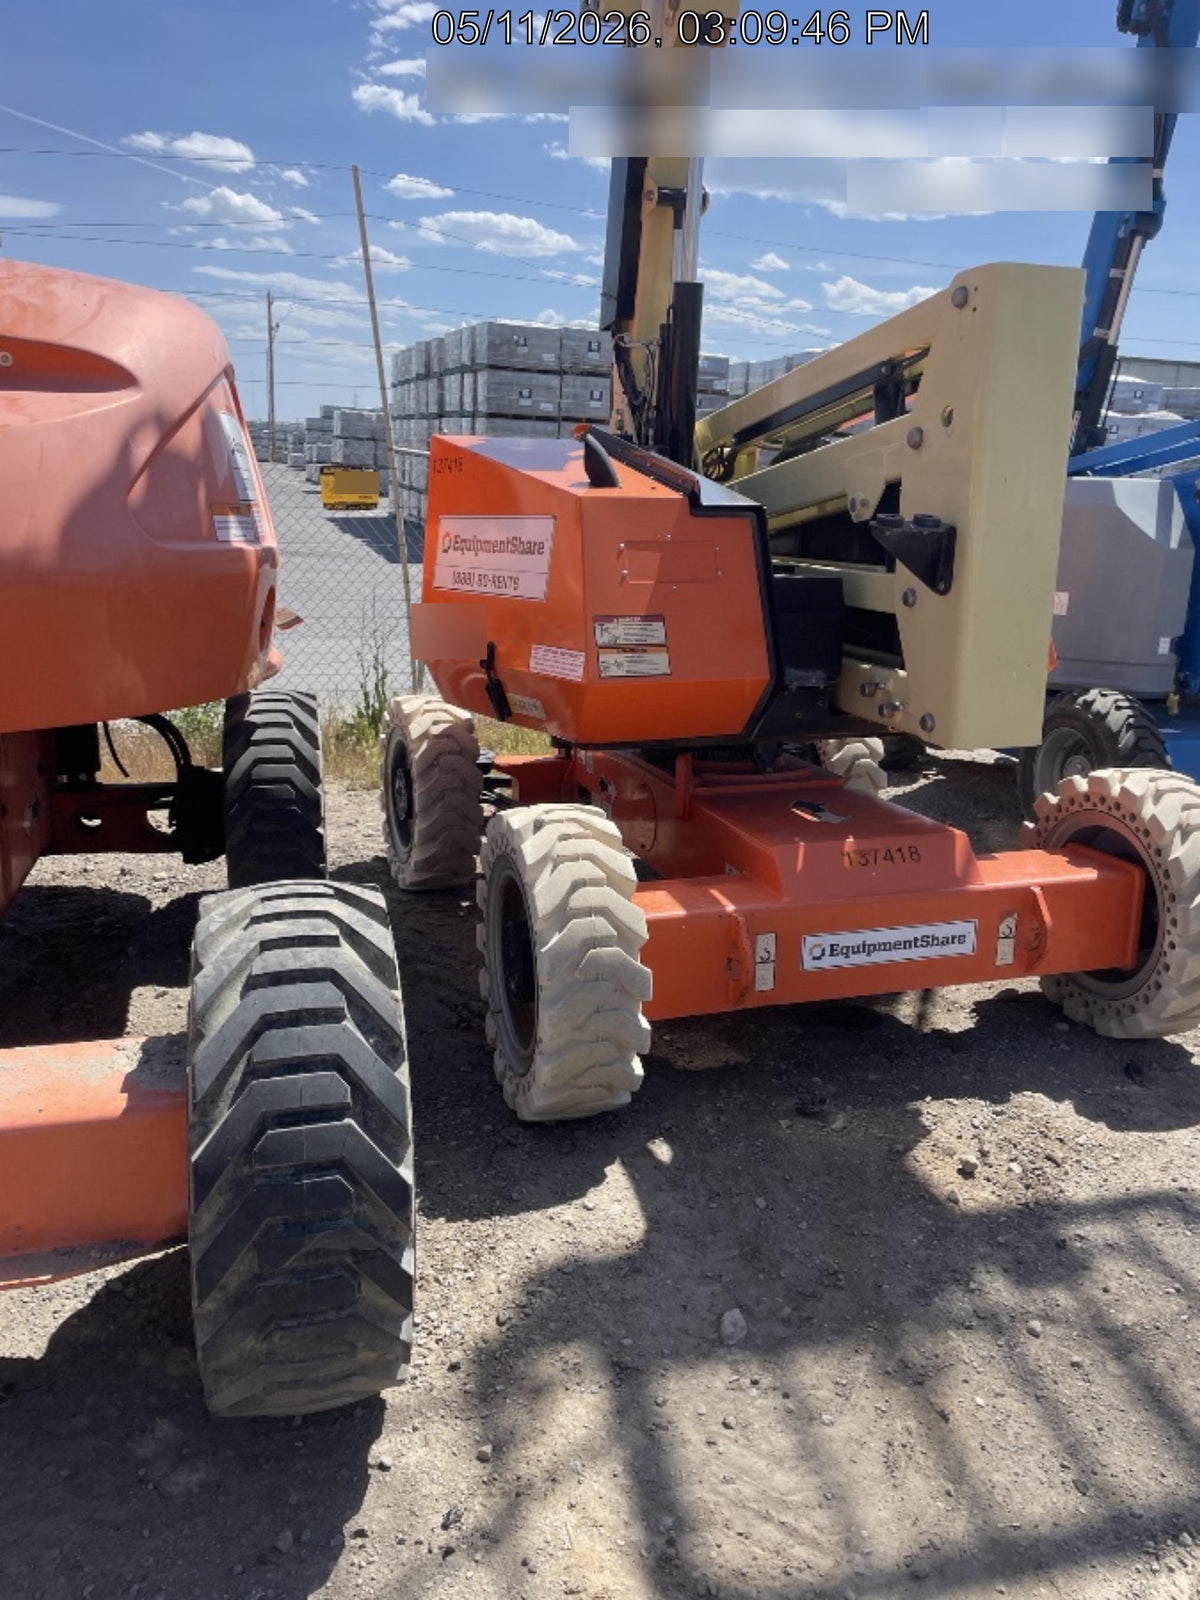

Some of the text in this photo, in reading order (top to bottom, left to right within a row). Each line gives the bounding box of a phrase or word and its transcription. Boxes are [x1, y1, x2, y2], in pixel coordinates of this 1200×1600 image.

[453, 534, 545, 556] EquipmentShare
[843, 846, 921, 867] 137418
[829, 933, 967, 959] EquipmentShare
